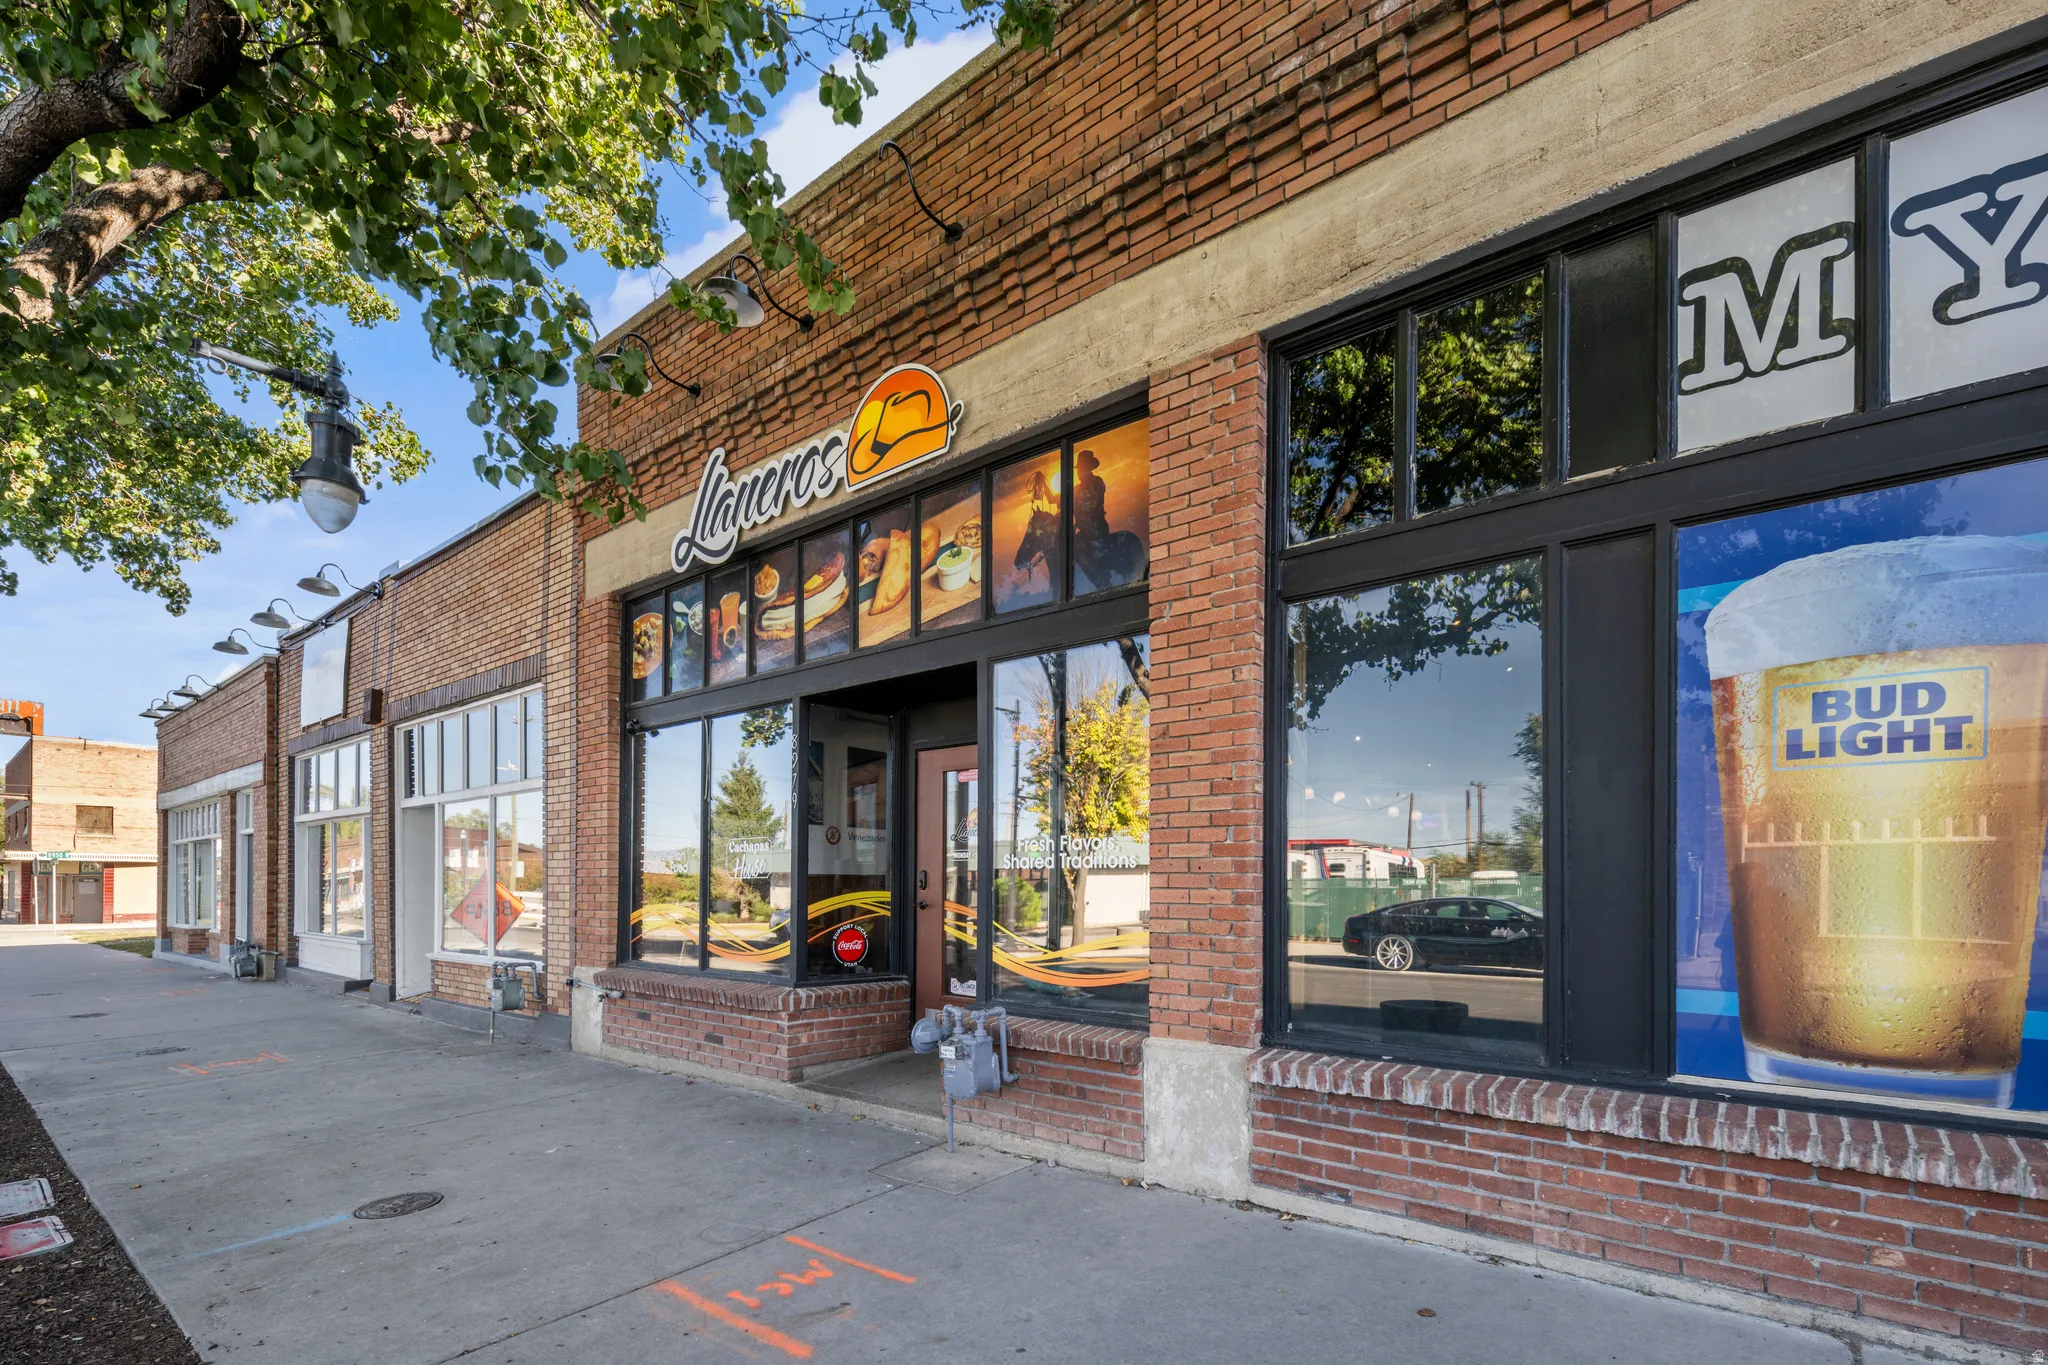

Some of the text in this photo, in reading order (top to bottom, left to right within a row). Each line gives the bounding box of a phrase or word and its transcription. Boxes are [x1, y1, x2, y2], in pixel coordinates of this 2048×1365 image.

[674, 436, 847, 568] Llaneros
[1811, 681, 1946, 724] BUD
[1785, 715, 1974, 761] LIGHT
[791, 733, 799, 810] 8979
[728, 841, 770, 853] Cachapas
[1017, 837, 1055, 852] Fresh
[733, 854, 766, 881] House
[1003, 851, 1137, 870] Shared Traditions
[833, 924, 868, 939] SUPPORT LOCAL
